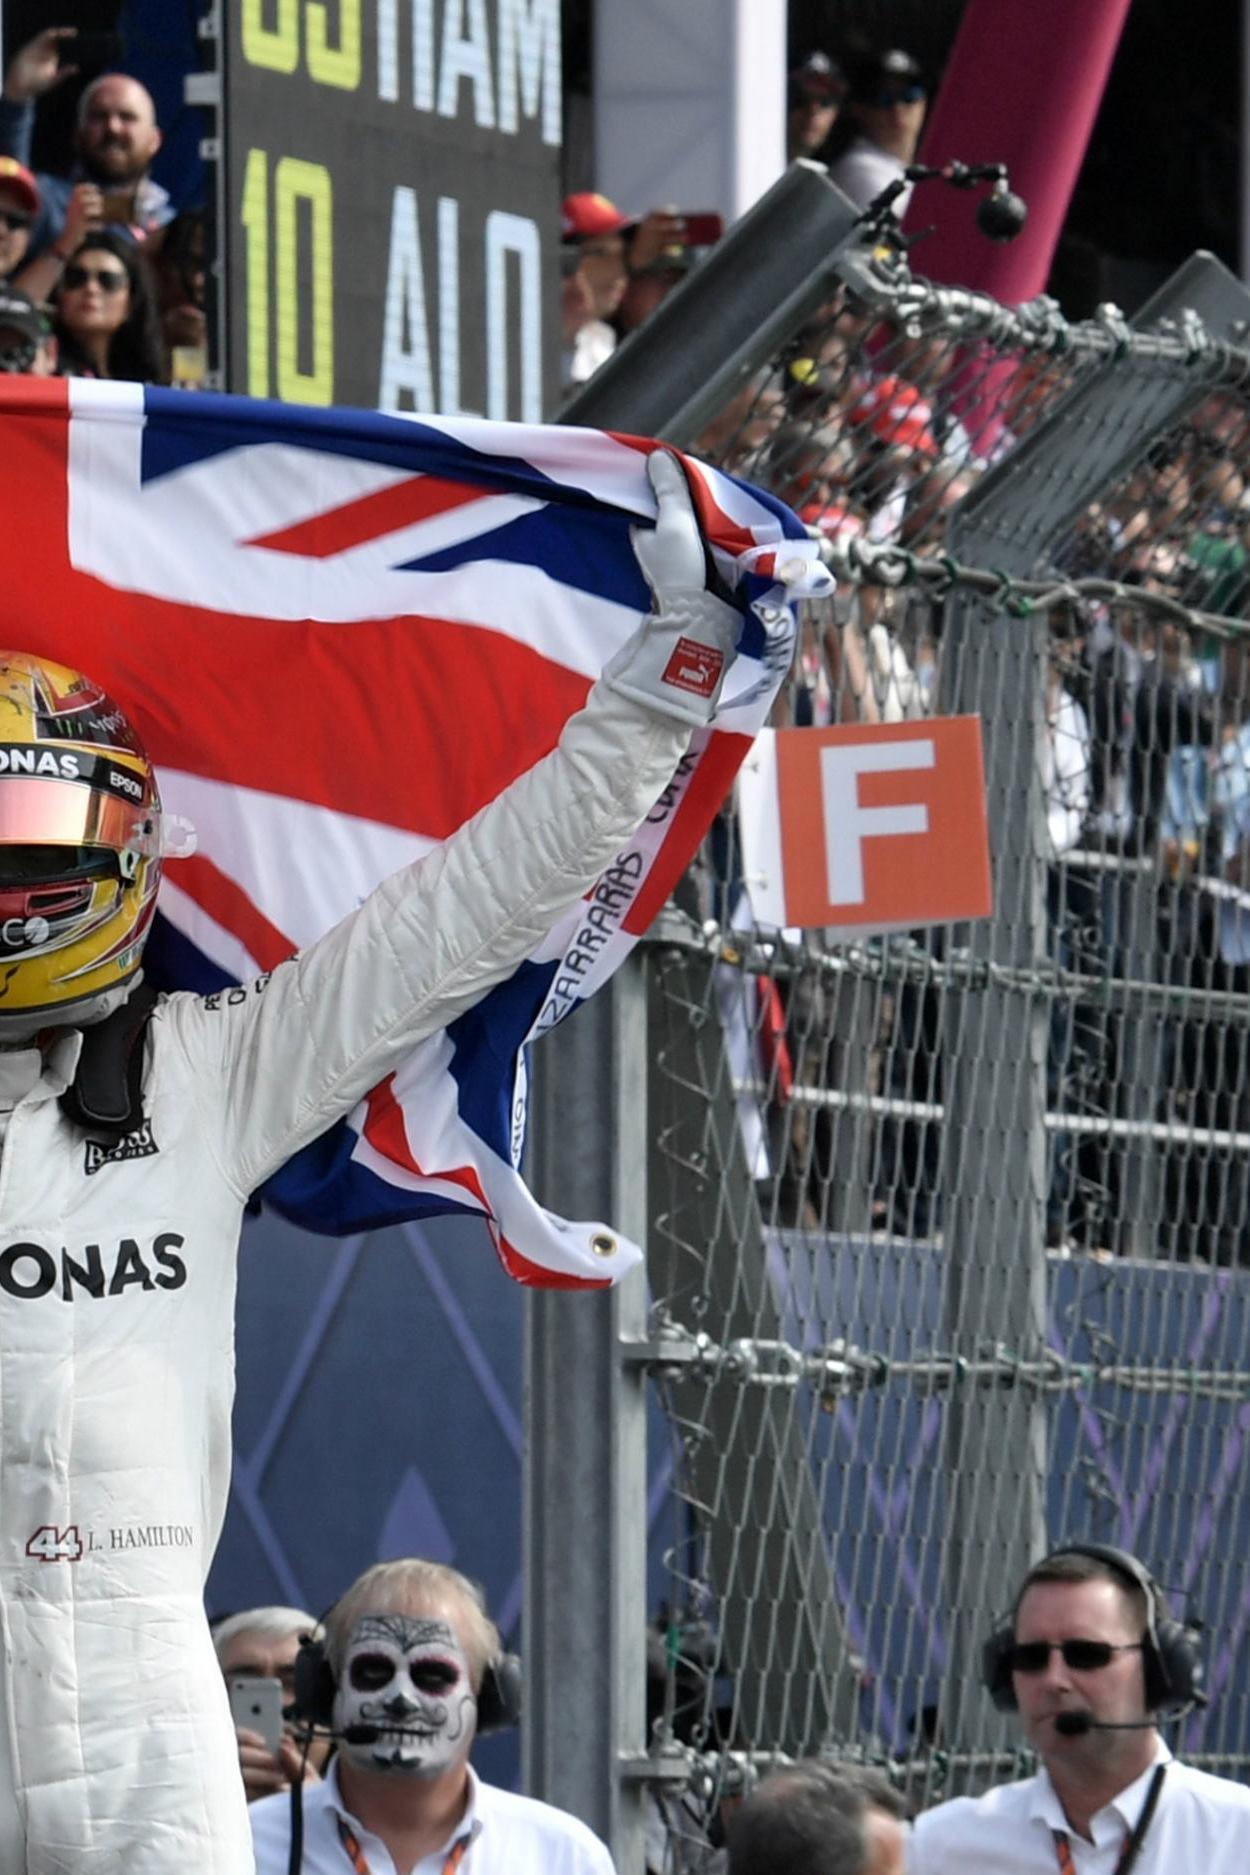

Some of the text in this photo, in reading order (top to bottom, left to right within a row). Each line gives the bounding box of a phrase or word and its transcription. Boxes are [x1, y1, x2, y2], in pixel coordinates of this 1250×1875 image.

[241, 148, 543, 424] 10 ALO
[110, 771, 142, 800] EPSON
[820, 738, 936, 906] F
[25, 1525, 194, 1563] 44 L. HAMILTON
